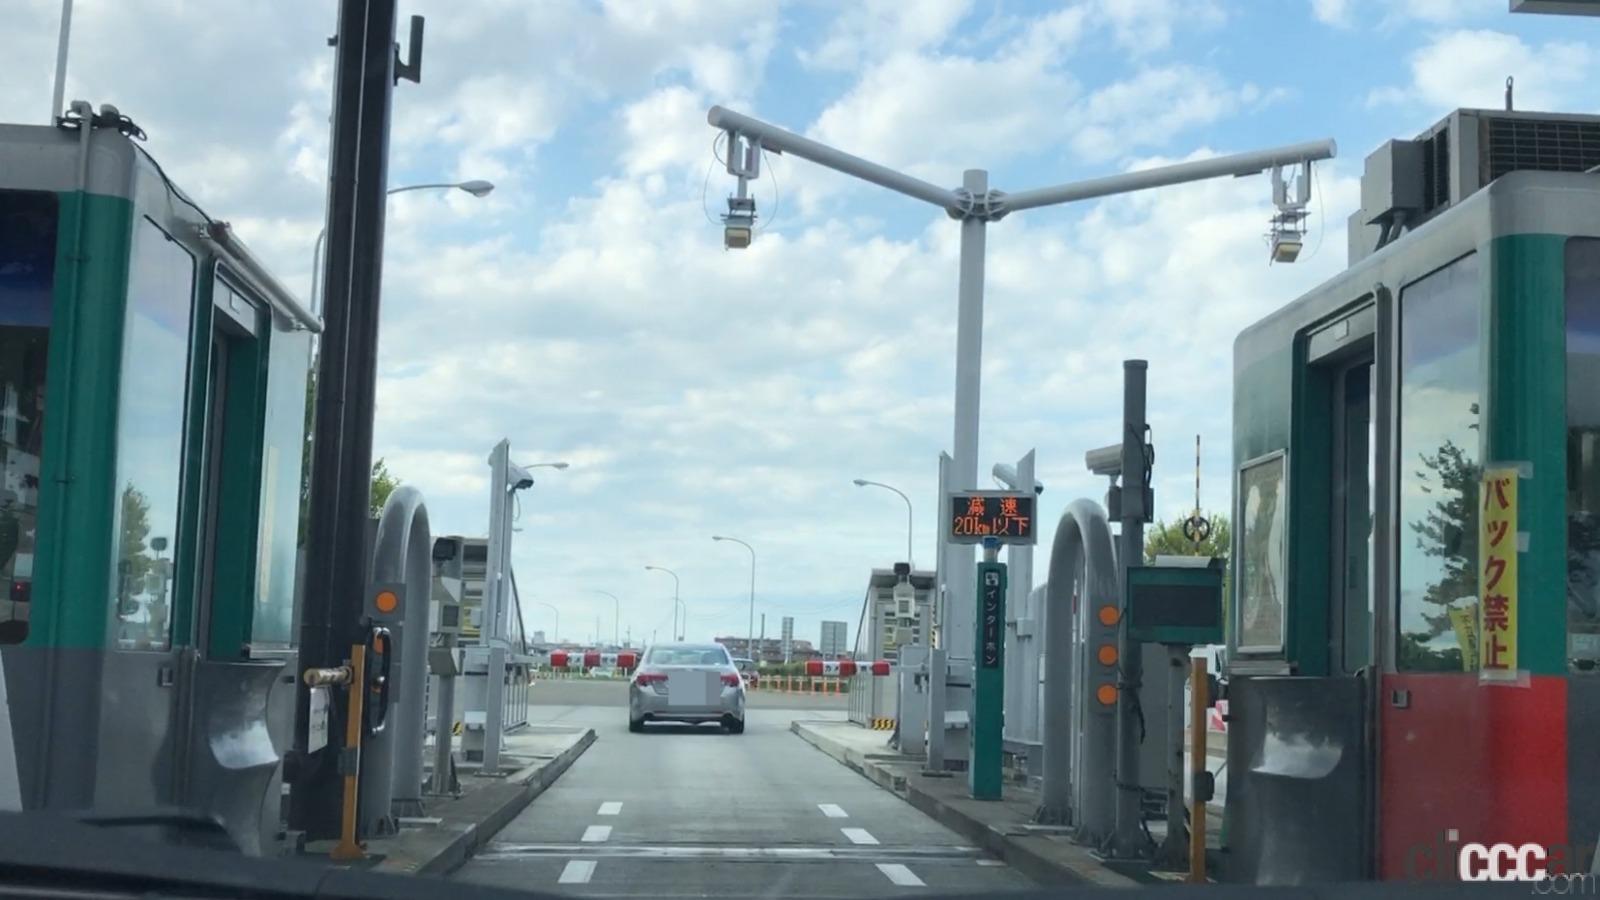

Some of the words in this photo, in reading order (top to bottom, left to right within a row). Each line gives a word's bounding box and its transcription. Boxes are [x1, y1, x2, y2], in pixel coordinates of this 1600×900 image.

[985, 590, 997, 664] インターホン
[1484, 478, 1510, 669] バック禁止
